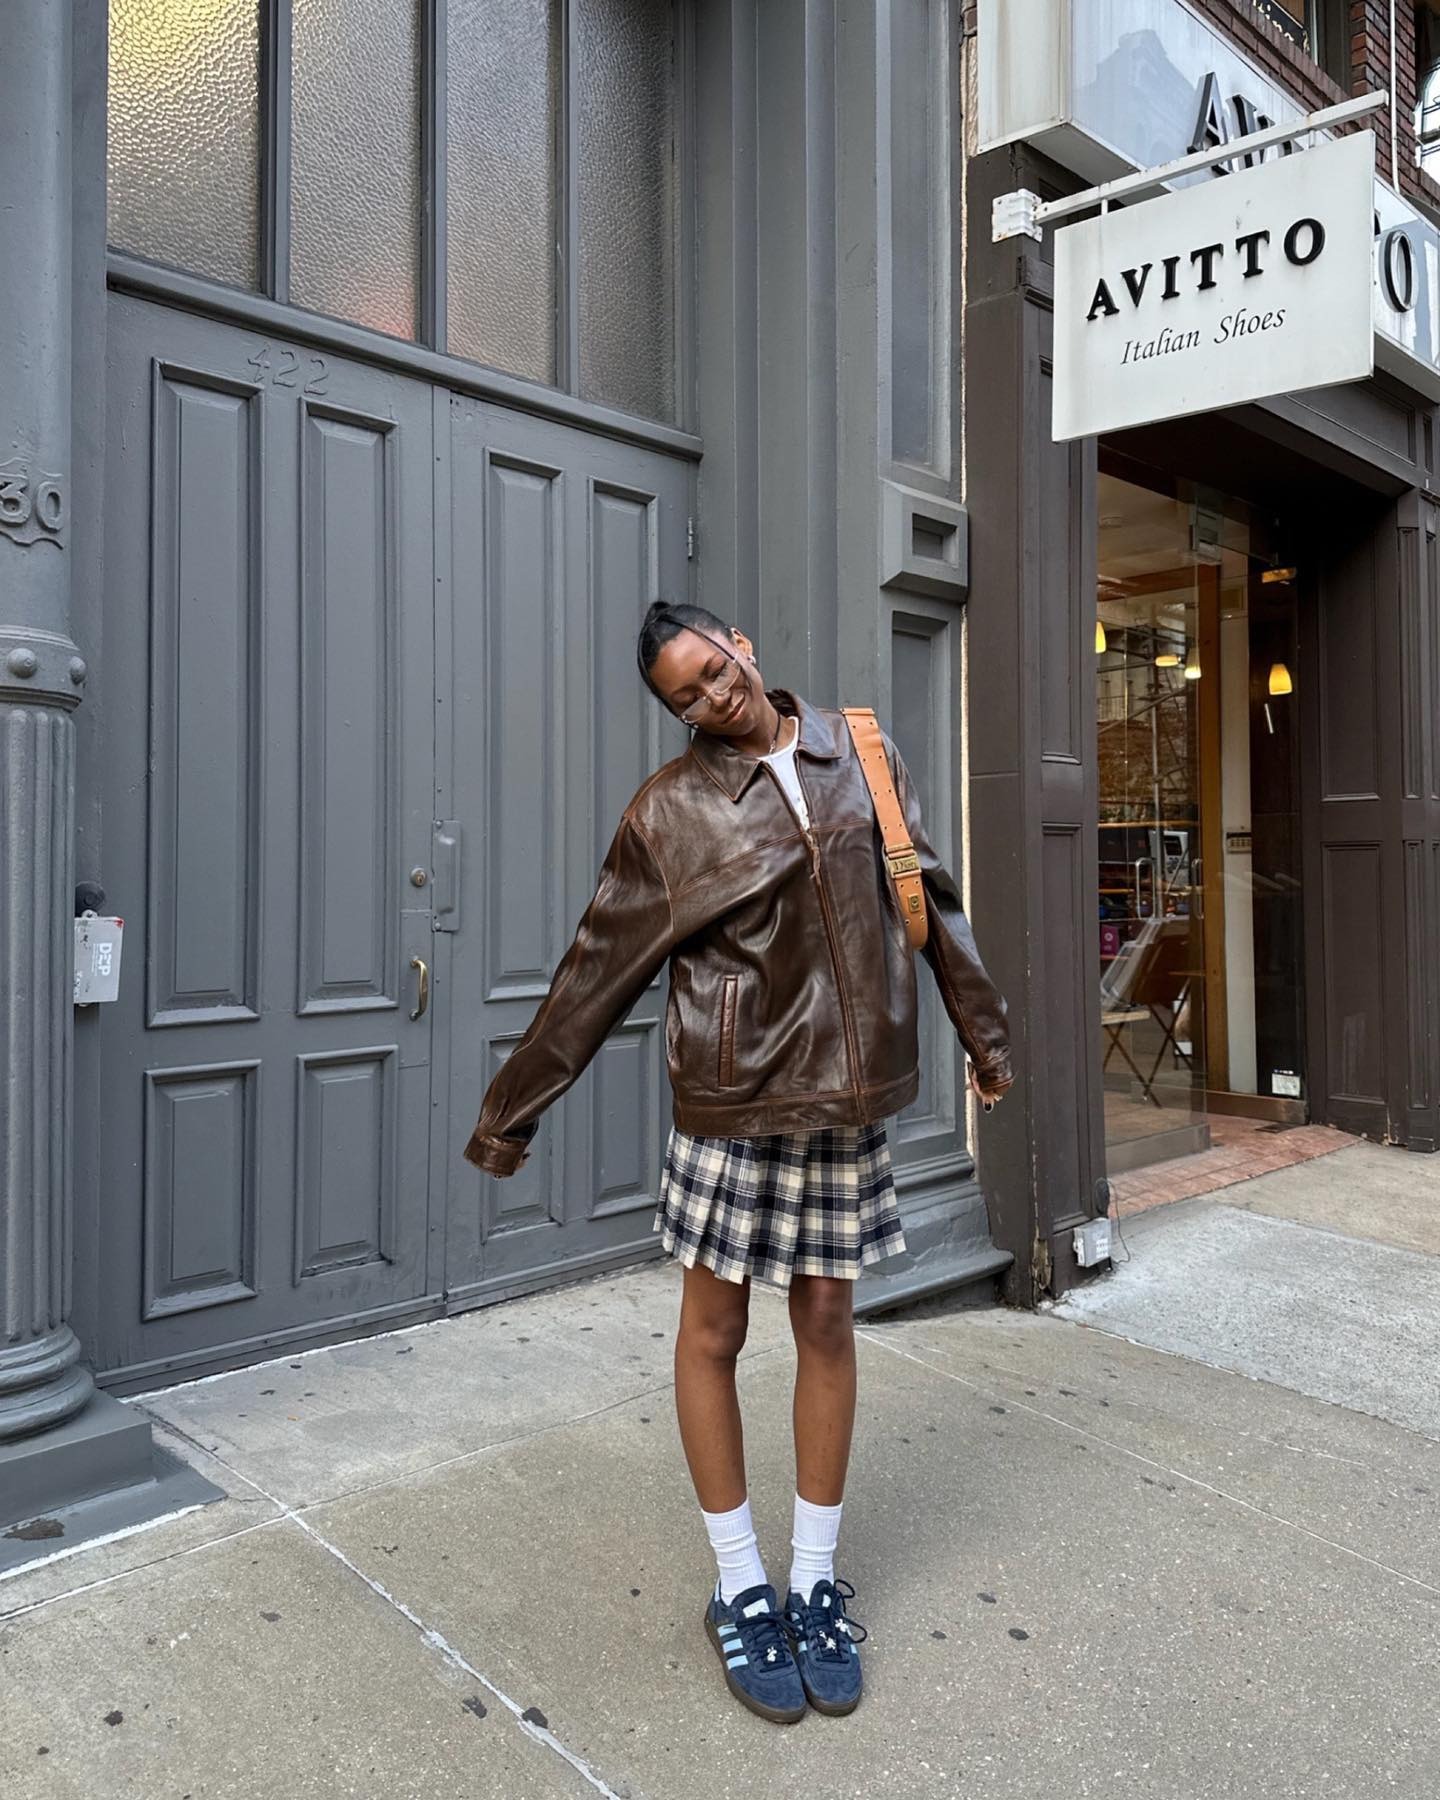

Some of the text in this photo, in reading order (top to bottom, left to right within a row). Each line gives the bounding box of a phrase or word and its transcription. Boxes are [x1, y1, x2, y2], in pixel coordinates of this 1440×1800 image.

[1086, 217, 1326, 322] AVITTO
[1120, 307, 1286, 365] Italian Shoes
[247, 341, 329, 396] 422
